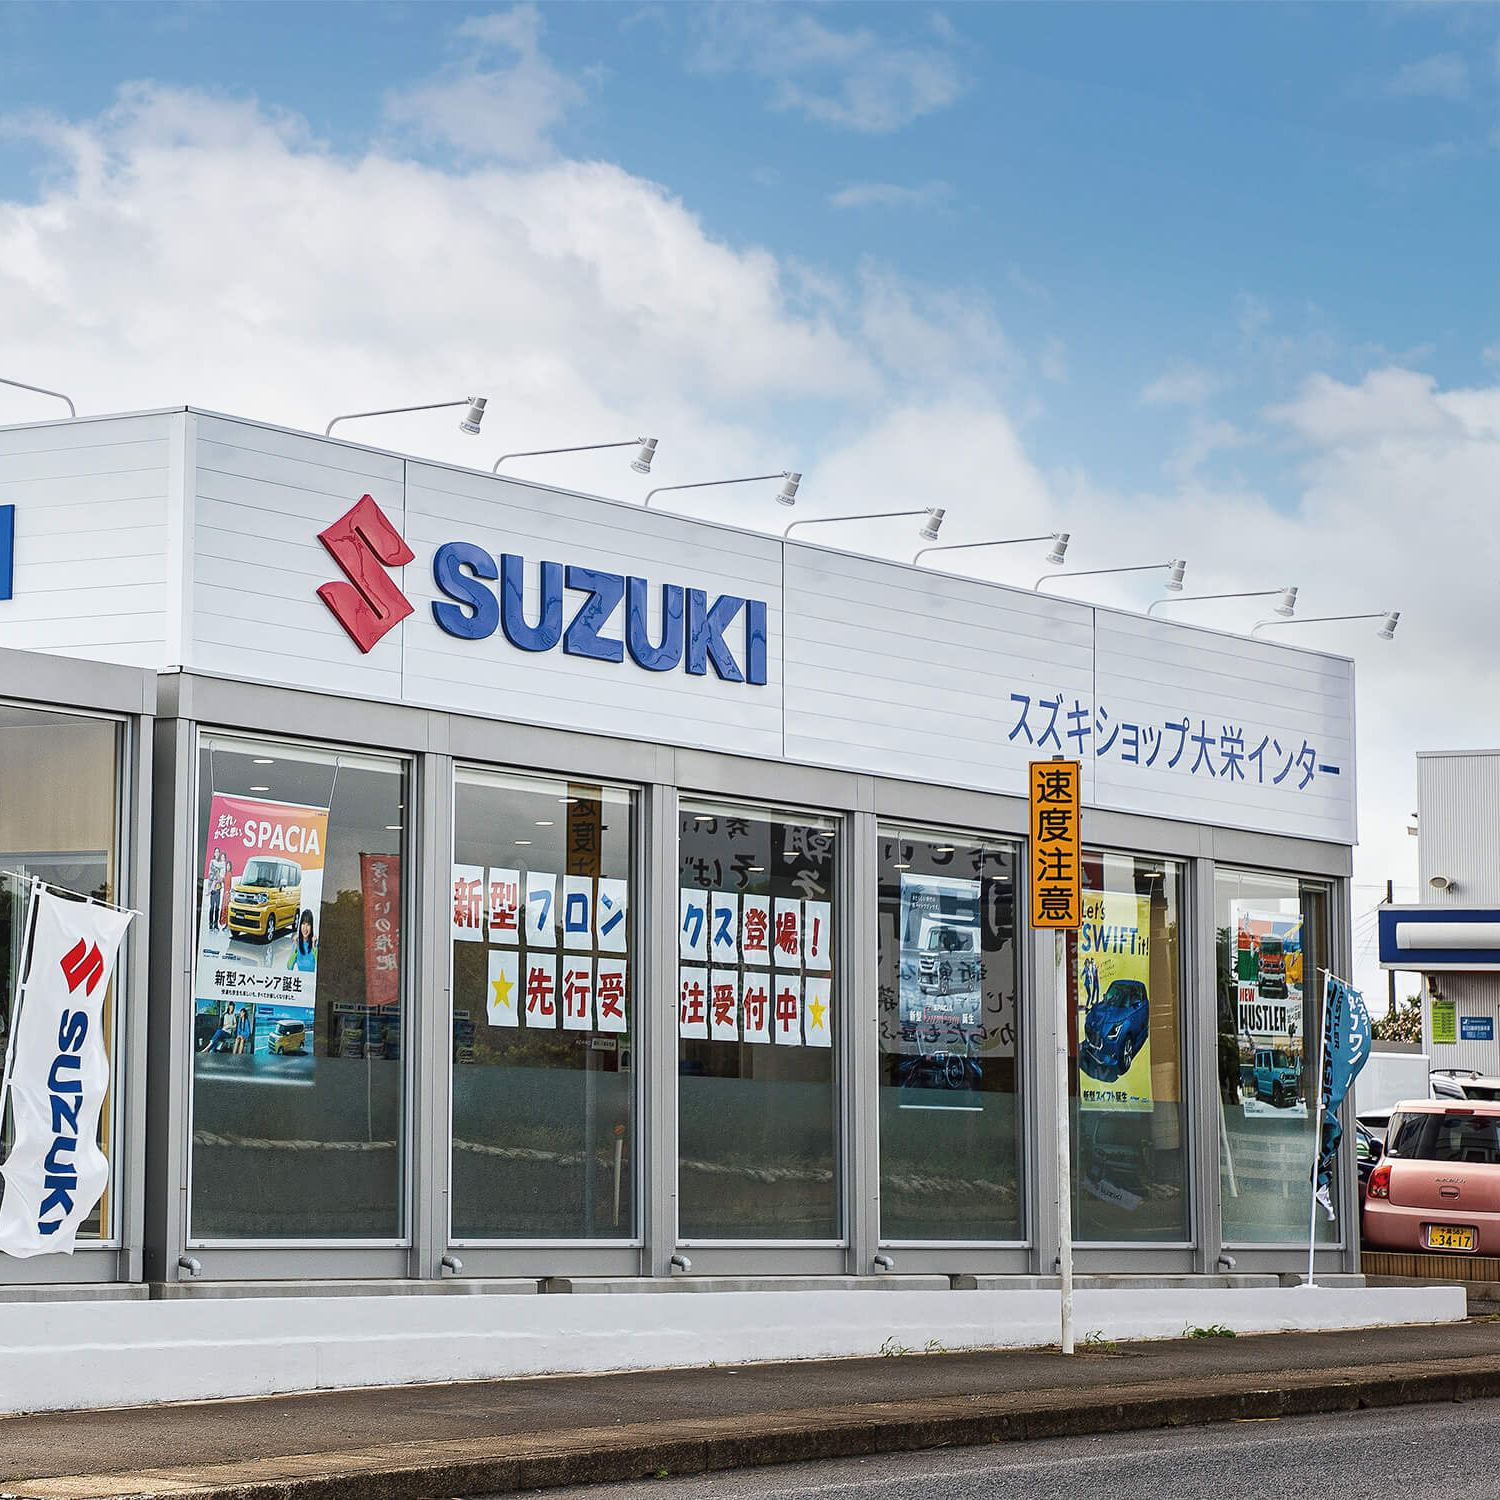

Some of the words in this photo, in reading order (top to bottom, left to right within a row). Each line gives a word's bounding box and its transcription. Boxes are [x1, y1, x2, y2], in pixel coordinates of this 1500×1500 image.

[431, 541, 768, 686] SUZUKI
[1008, 692, 1341, 790] スズキショップ大栄インター
[243, 819, 321, 856] SPACIA
[1036, 769, 1073, 921] 速度注意
[1081, 923, 1139, 955] SWIFT
[214, 969, 302, 993] 新型スペーシア誕生
[1239, 988, 1255, 1003] NEW
[1239, 1004, 1287, 1032] HUSTLER
[39, 1009, 89, 1235] SUZUKI
[1439, 1234, 1471, 1248] 34-17
